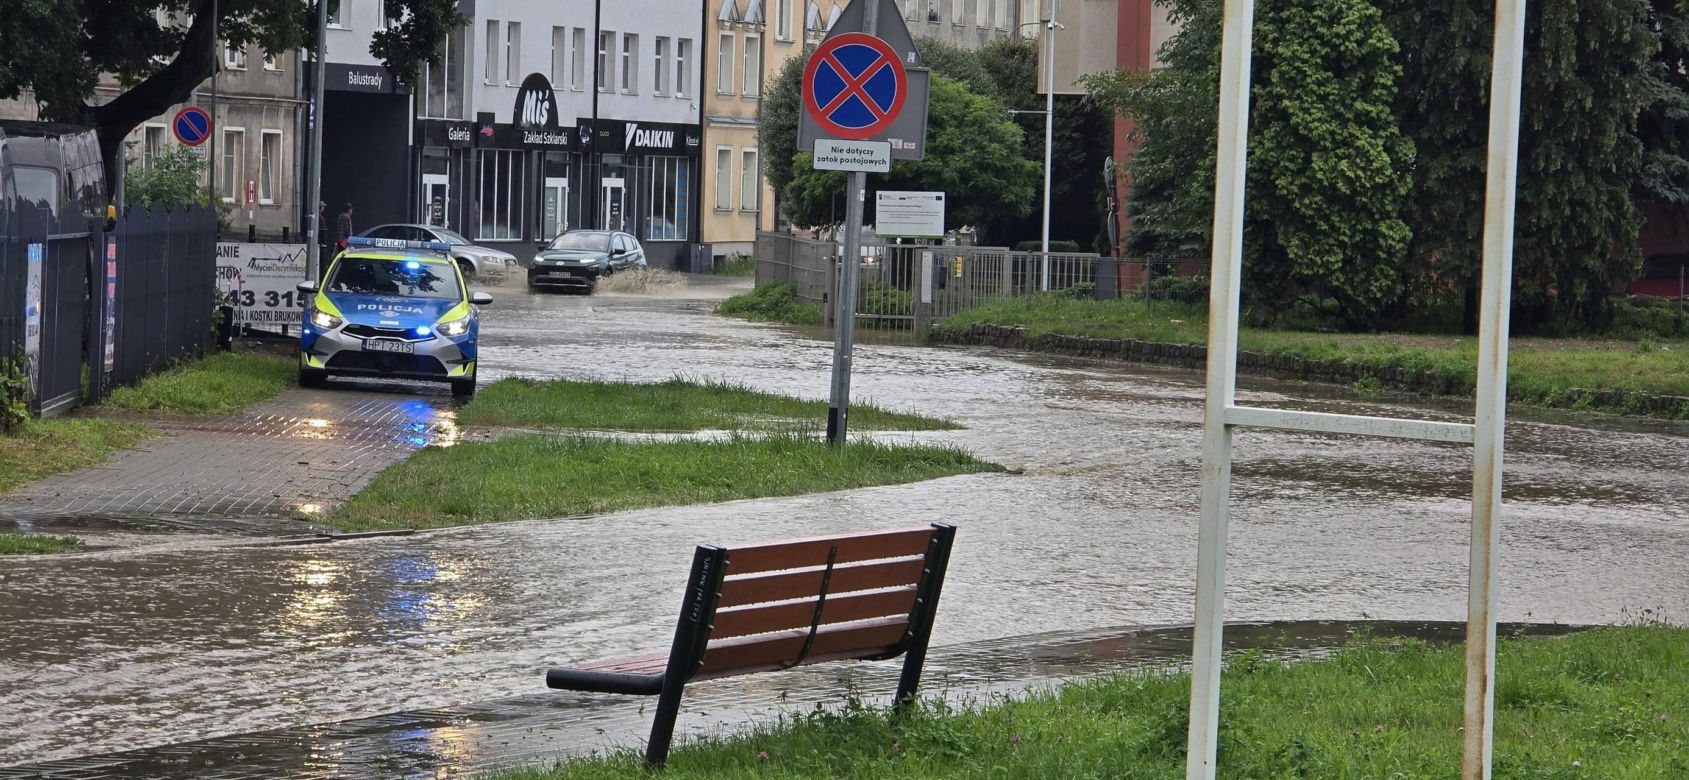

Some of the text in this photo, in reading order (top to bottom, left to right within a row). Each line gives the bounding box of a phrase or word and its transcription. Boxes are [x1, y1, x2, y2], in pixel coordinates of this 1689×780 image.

[348, 71, 383, 90] Balustrady
[522, 89, 550, 126] Miś
[448, 127, 470, 141] Galeria
[523, 131, 568, 145] Zakład Szklarski
[634, 129, 674, 148] DAIKIN
[831, 146, 875, 156] Nie dotyczy
[840, 157, 887, 166] postojowych
[376, 240, 405, 248] POLICJA
[250, 310, 273, 321] KOSTKI
[357, 304, 424, 314] POLICJA
[368, 340, 412, 353] HPT 23TS
